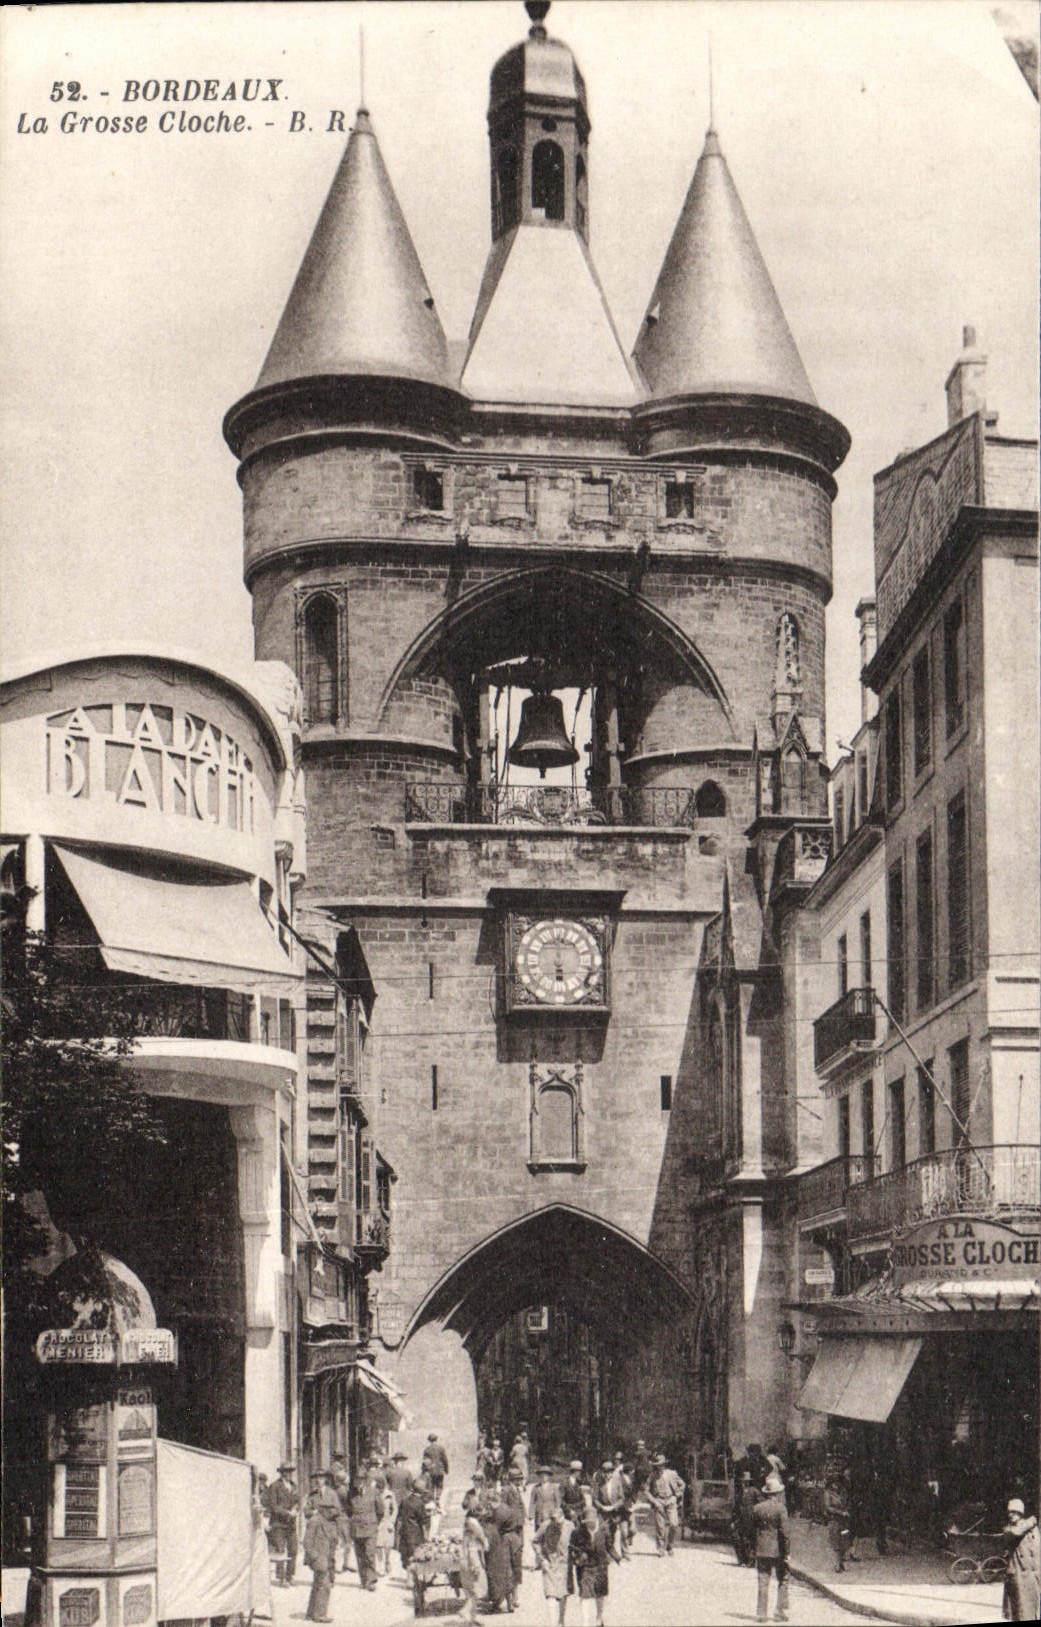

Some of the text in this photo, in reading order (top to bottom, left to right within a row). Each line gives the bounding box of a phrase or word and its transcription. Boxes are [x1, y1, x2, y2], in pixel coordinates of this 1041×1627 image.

[64, 707, 97, 735] A
[112, 703, 163, 747] LA
[937, 1223, 976, 1239] A LA
[893, 1241, 1040, 1267] ROSSE CLOCH
[46, 1347, 106, 1360] MENIER
